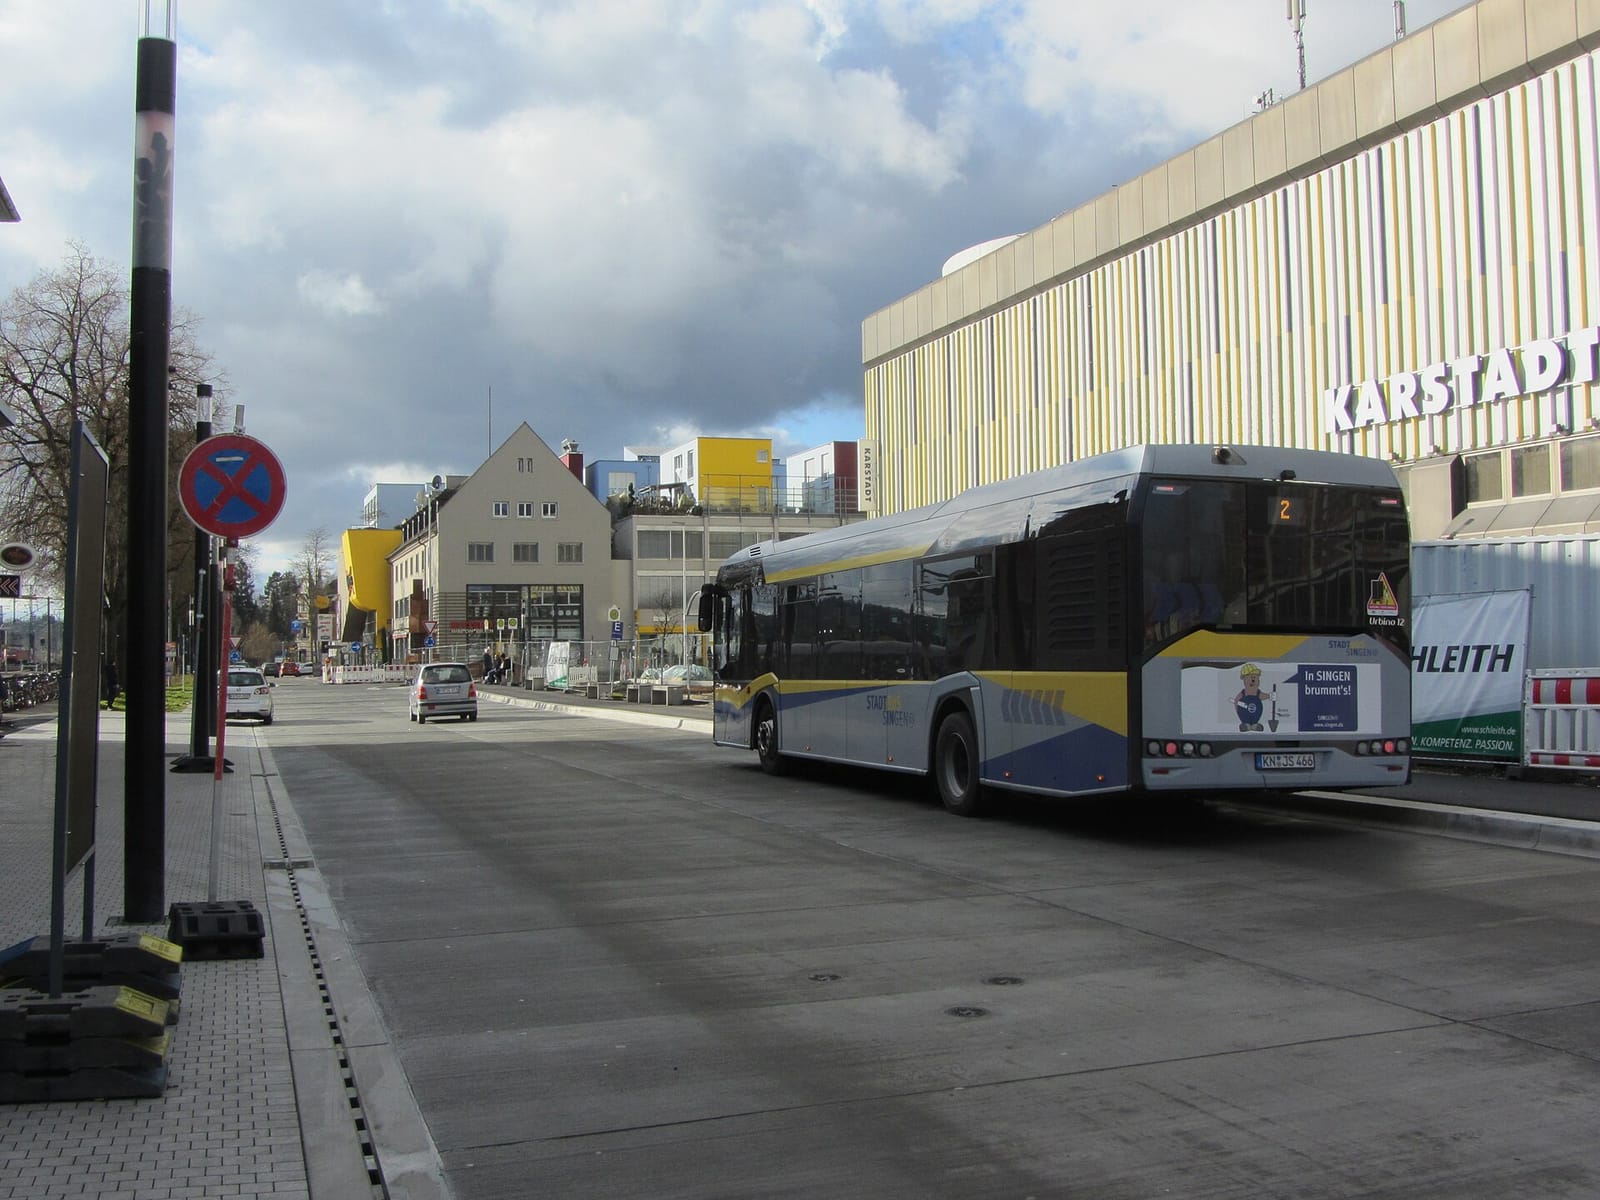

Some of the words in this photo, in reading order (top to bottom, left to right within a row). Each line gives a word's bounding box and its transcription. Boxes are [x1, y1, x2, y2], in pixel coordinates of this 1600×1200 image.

[1325, 326, 1600, 433] KARSTADT
[1280, 500, 1290, 519] 2
[1369, 617, 1396, 626] Urbino
[1397, 618, 1405, 626] 12
[1305, 671, 1314, 681] In
[1316, 671, 1351, 681] SINGEN
[1305, 684, 1352, 695] brummt's!
[1461, 726, 1516, 735] www.schleith.de
[1420, 737, 1473, 749] KOMPETENZ.
[1475, 739, 1515, 751] PASSION.
[1262, 754, 1275, 768] KN
[1282, 755, 1294, 767] JS
[1296, 755, 1313, 767] 466
